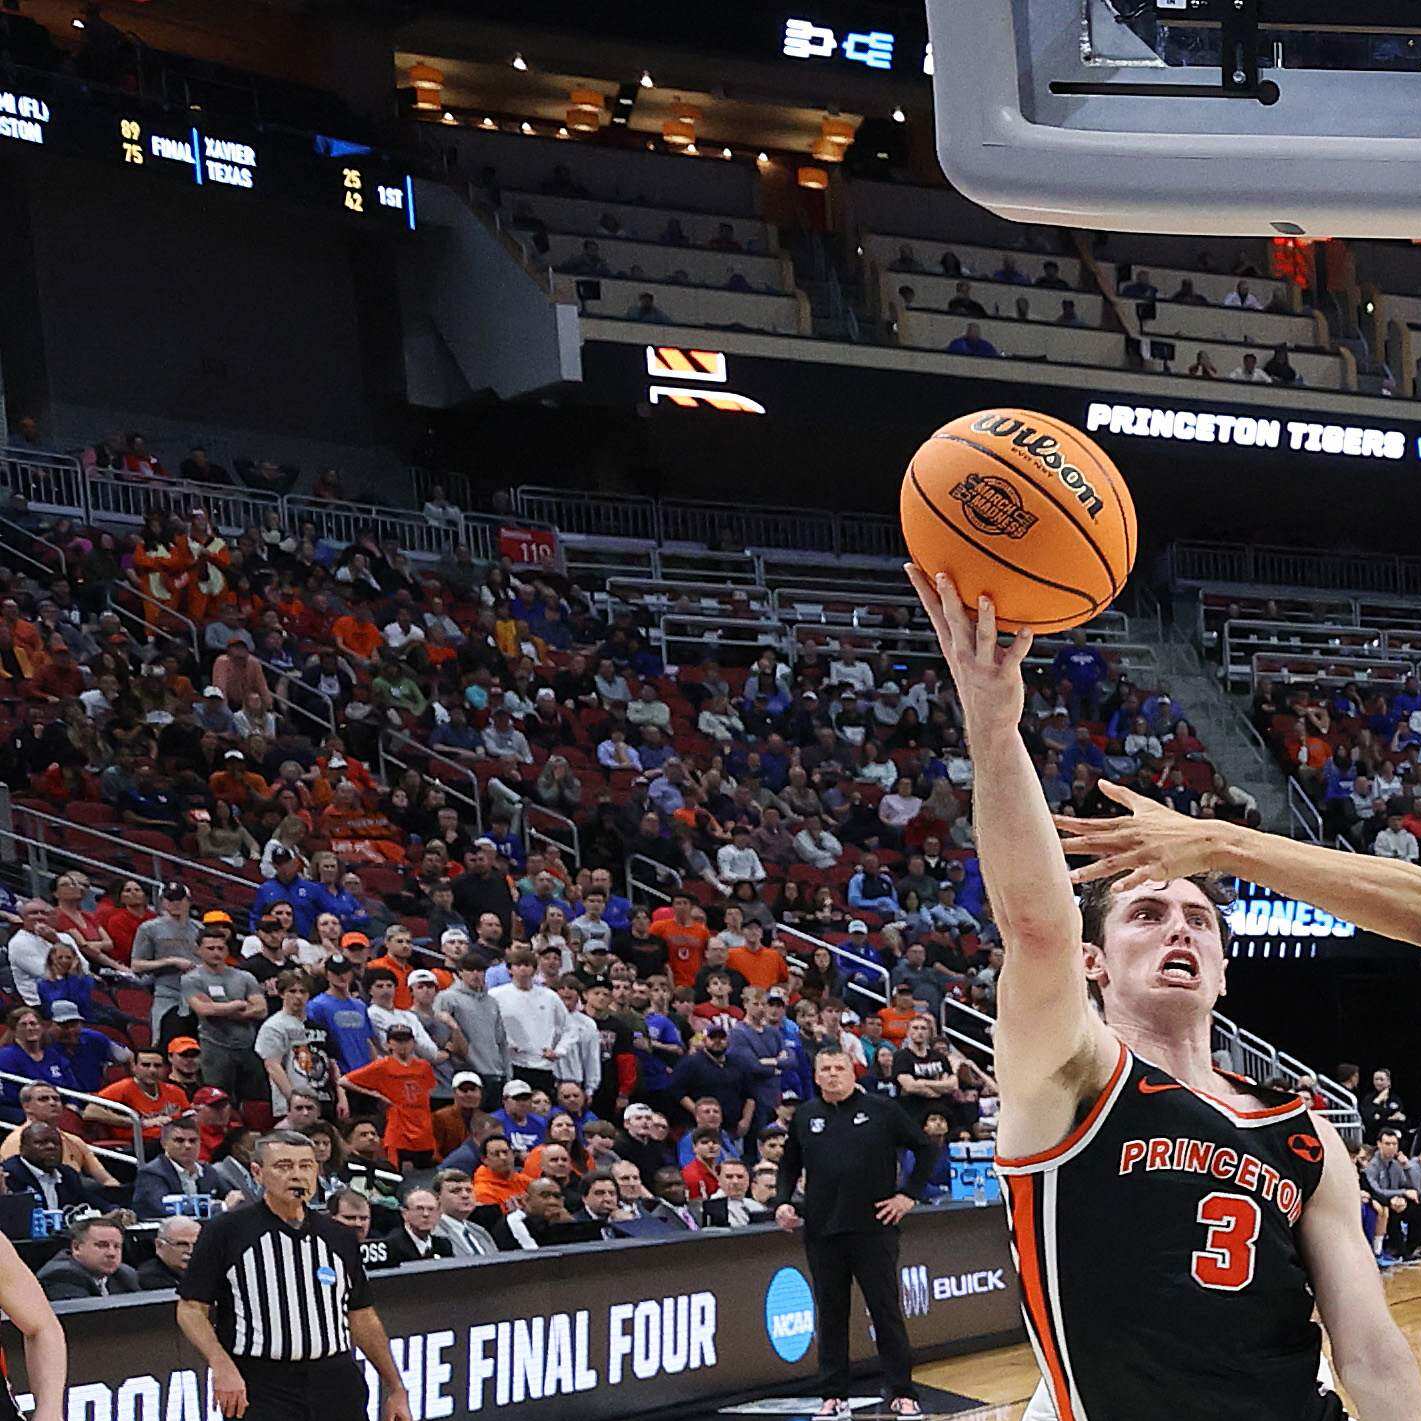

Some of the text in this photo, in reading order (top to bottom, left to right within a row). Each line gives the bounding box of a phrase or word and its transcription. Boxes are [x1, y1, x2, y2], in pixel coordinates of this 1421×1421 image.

[120, 118, 141, 140] 89
[122, 143, 144, 165] 75
[151, 135, 196, 164] FINAL
[204, 136, 257, 167] XAVIER
[205, 160, 254, 189] TEXAS
[342, 168, 362, 190] 25
[344, 191, 364, 213] 42
[377, 186, 404, 210] 1ST
[1086, 403, 1281, 448] PRINCETON
[1287, 421, 1406, 460] TIGERS
[971, 414, 1104, 520] Wilson
[974, 479, 1018, 517] MARCH
[1227, 899, 1356, 938] ADNESS
[1190, 1191, 1262, 1292] 3
[933, 1268, 1006, 1300] BUICK
[772, 1310, 815, 1338] NCAA
[467, 1311, 598, 1413] FINAL
[607, 1291, 717, 1385] FOUR
